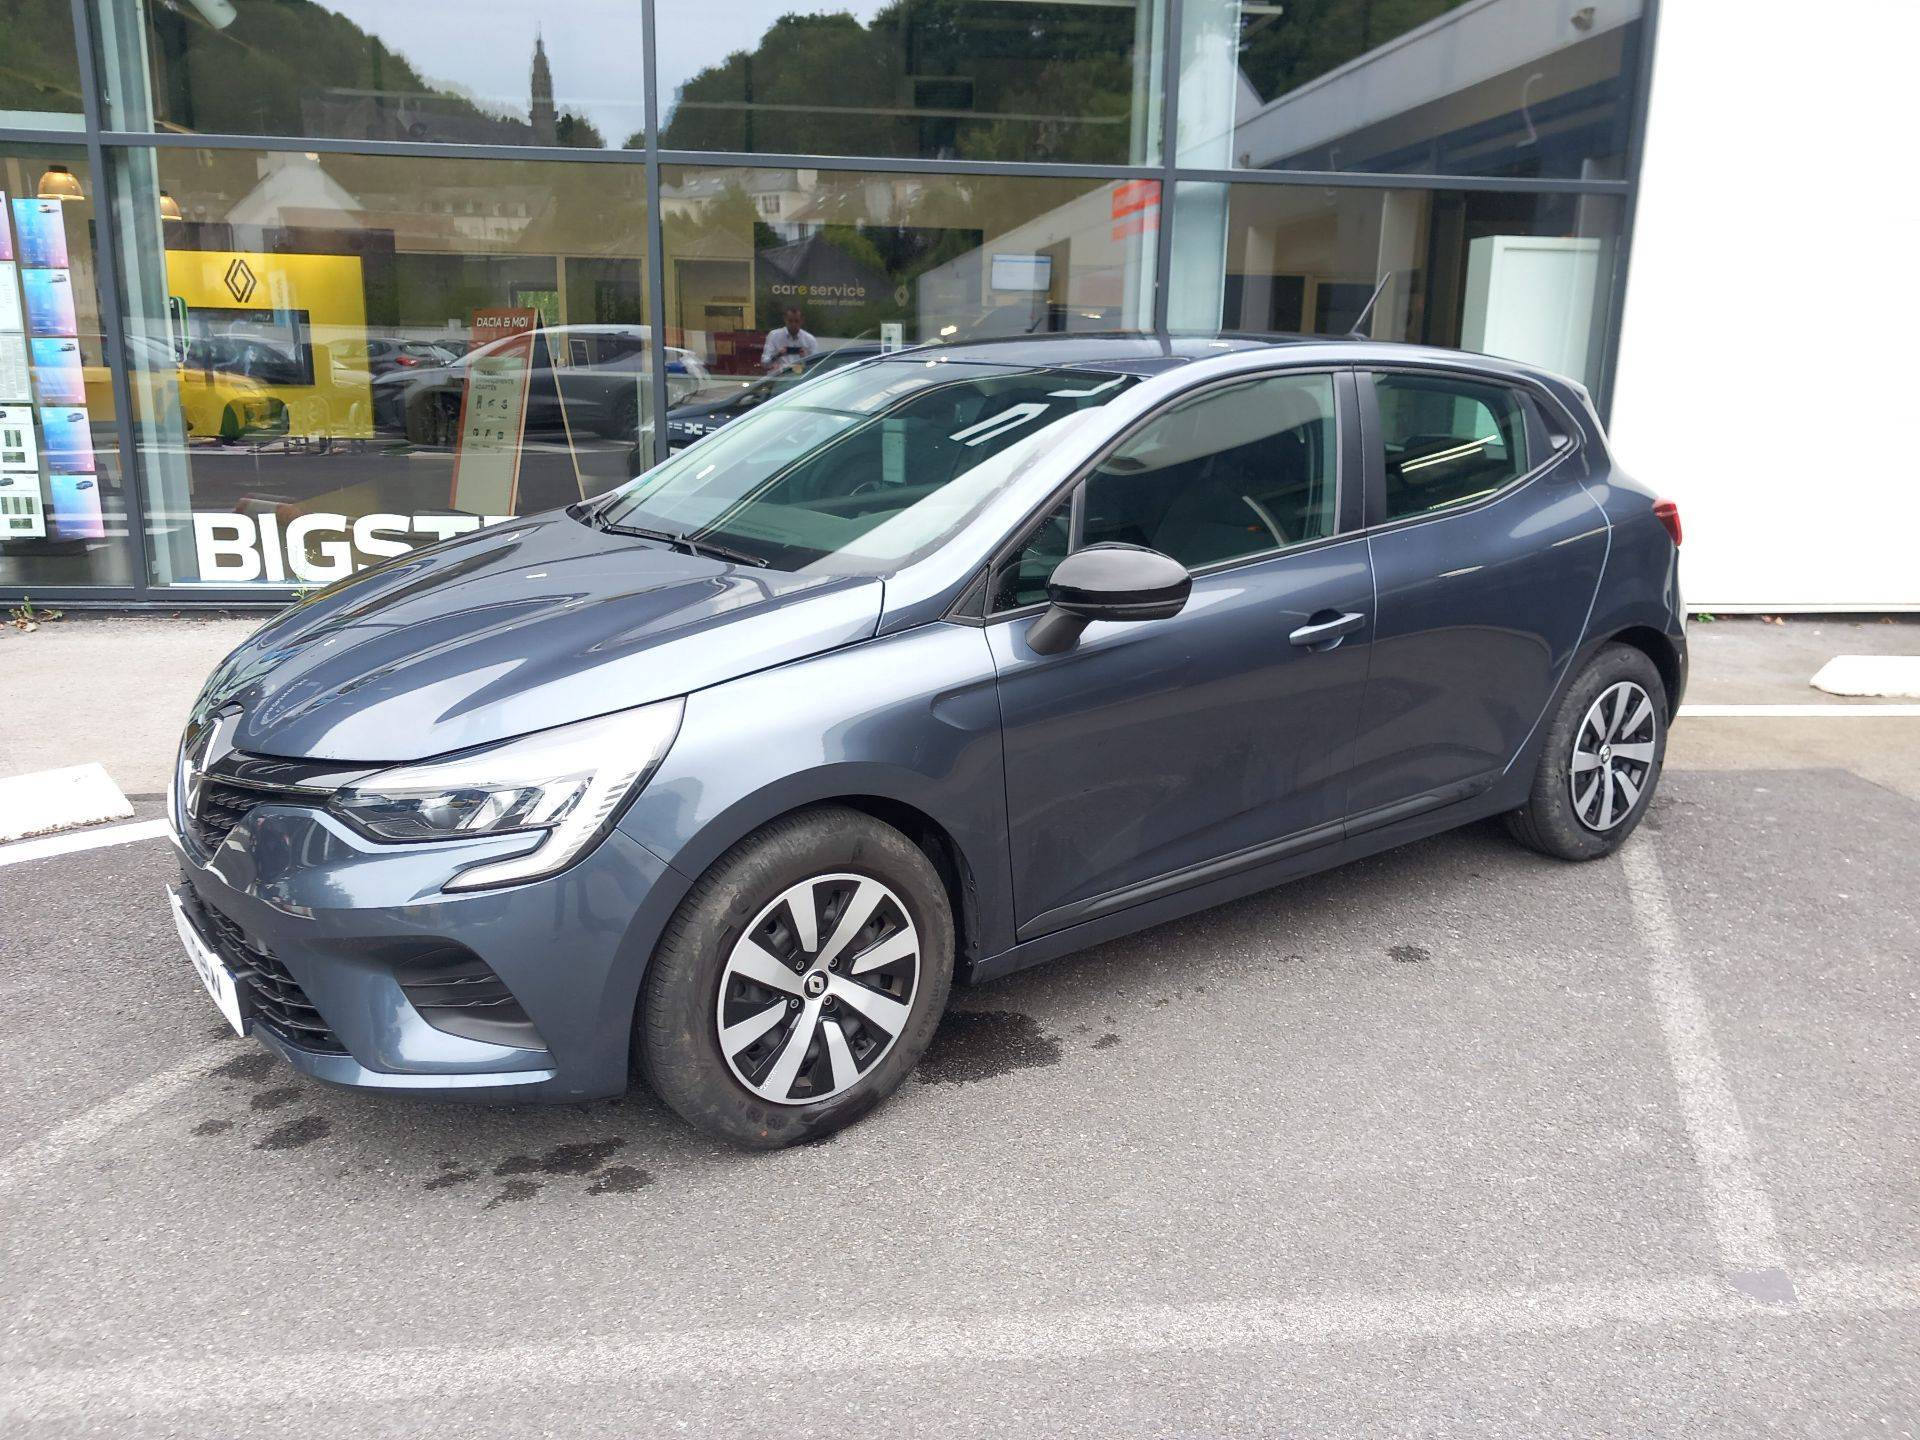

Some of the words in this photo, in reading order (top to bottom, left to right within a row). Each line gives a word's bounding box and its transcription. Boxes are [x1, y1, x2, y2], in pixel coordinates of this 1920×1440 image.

[771, 284, 807, 296] care
[810, 283, 865, 297] service
[476, 316, 501, 327] DACIA
[503, 317, 511, 327] &
[512, 316, 528, 328] MOI
[192, 512, 521, 582] BIGST
